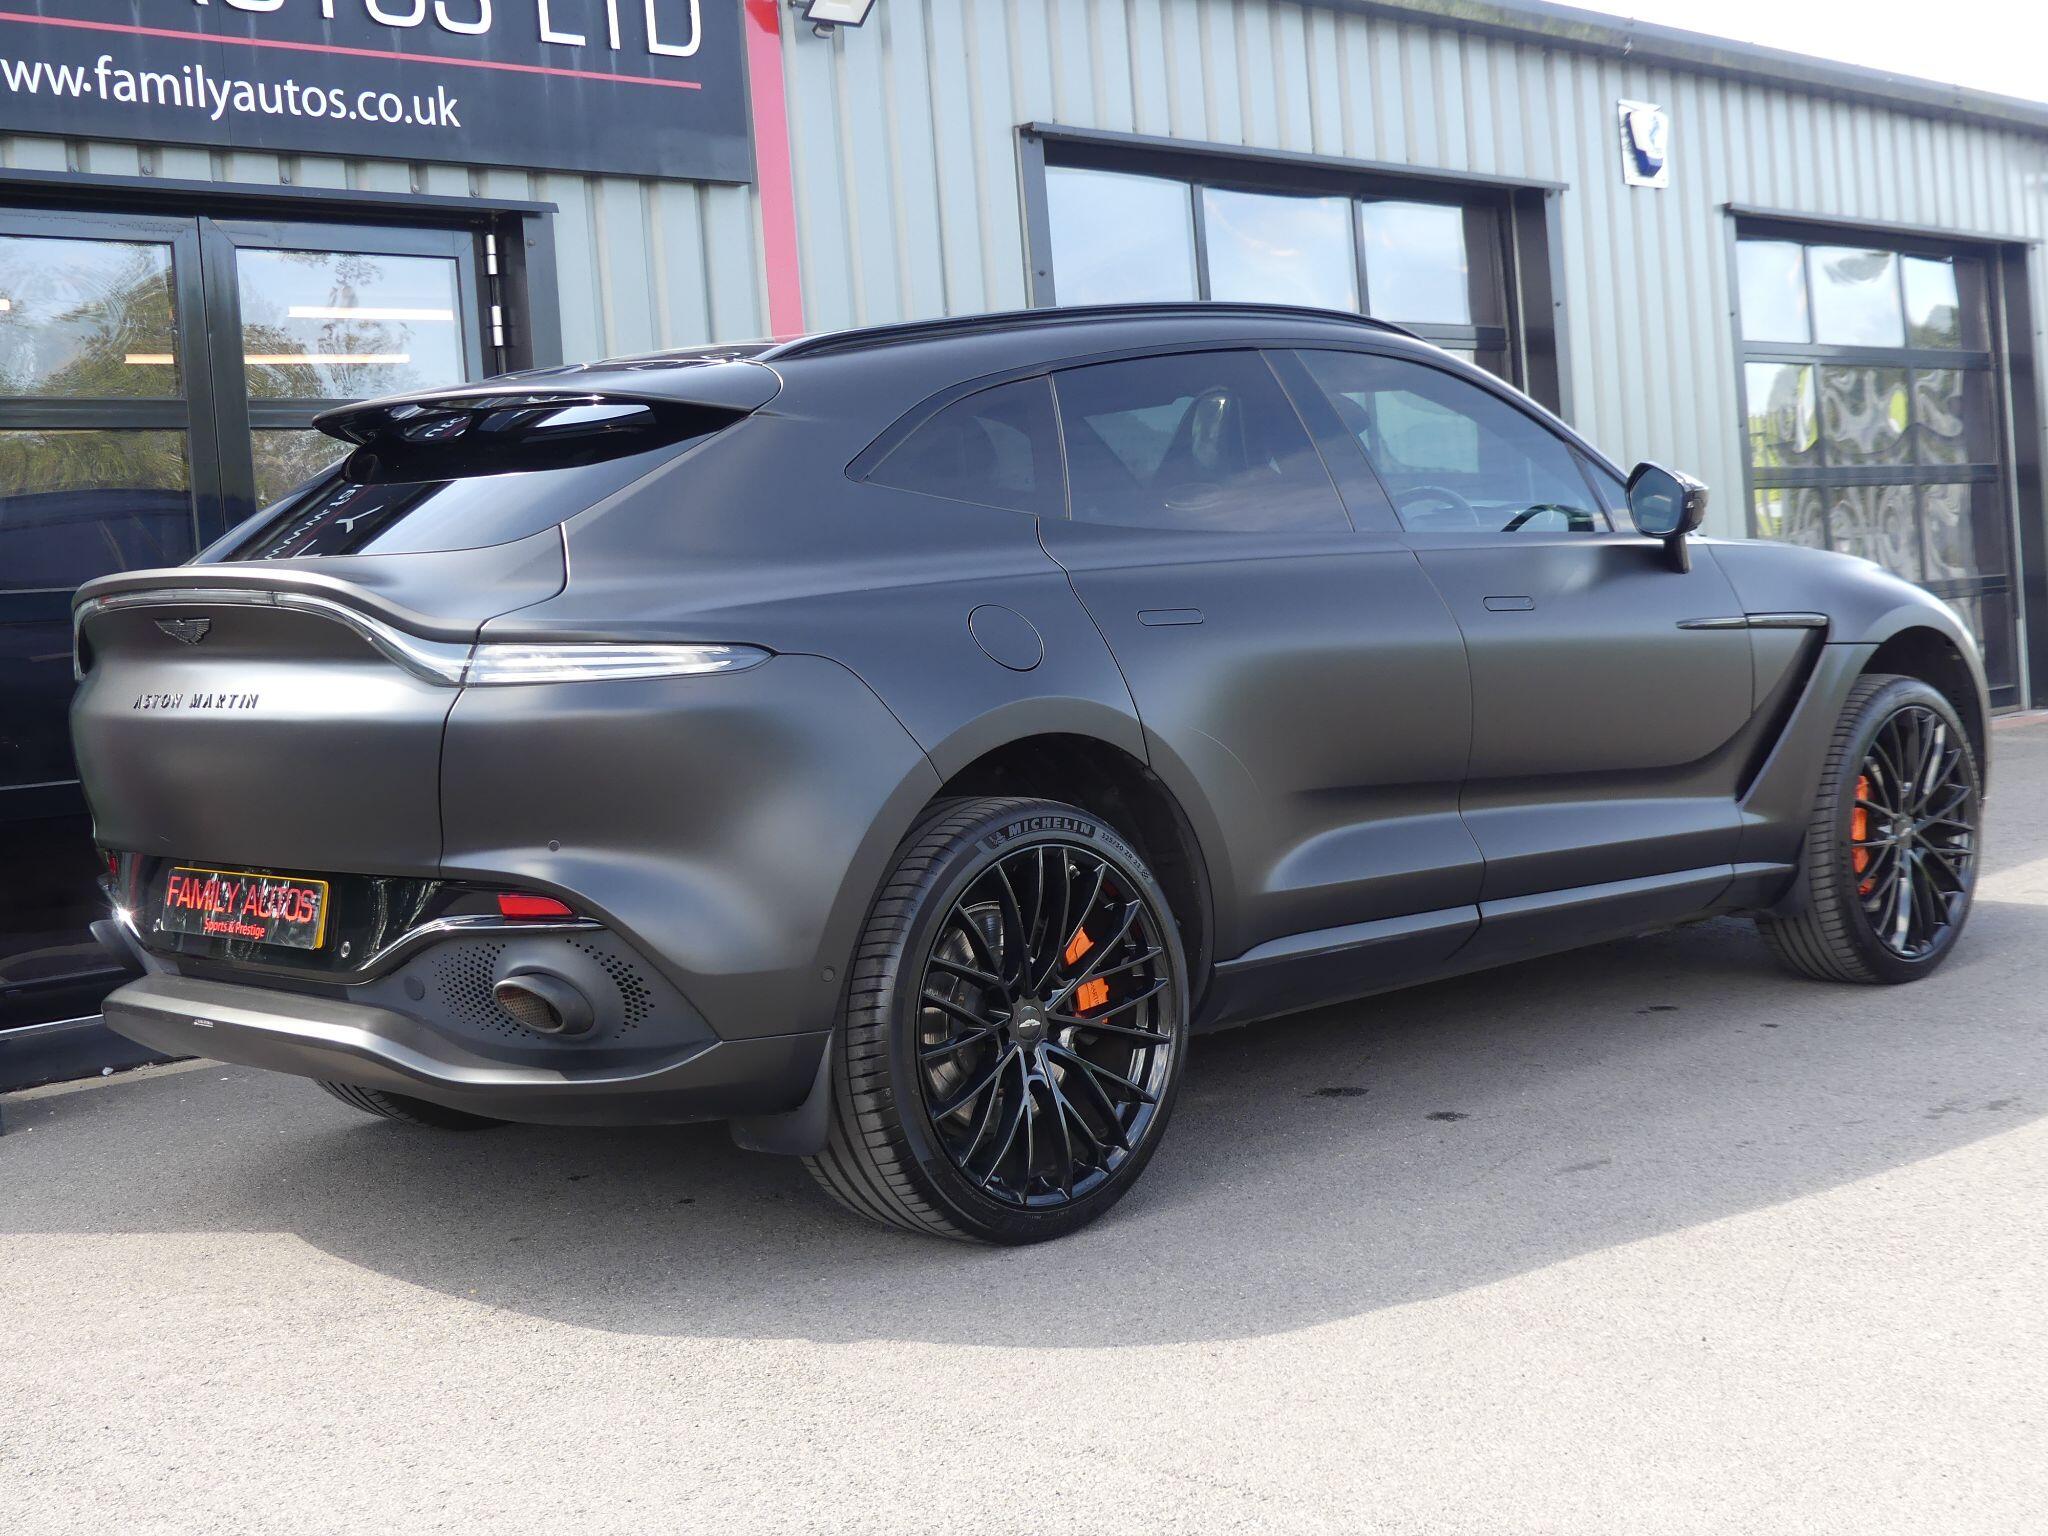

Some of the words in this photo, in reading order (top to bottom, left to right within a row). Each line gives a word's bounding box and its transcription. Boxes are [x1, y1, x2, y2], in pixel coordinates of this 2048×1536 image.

[133, 693, 184, 709] ASTON
[188, 693, 260, 709] MARTIN
[1008, 817, 1092, 837] MICHELIN
[167, 876, 240, 913] FAMILY
[242, 882, 314, 924] AUTOS
[204, 918, 228, 933] Sports
[228, 921, 235, 933] &
[235, 921, 265, 940] Prestige
